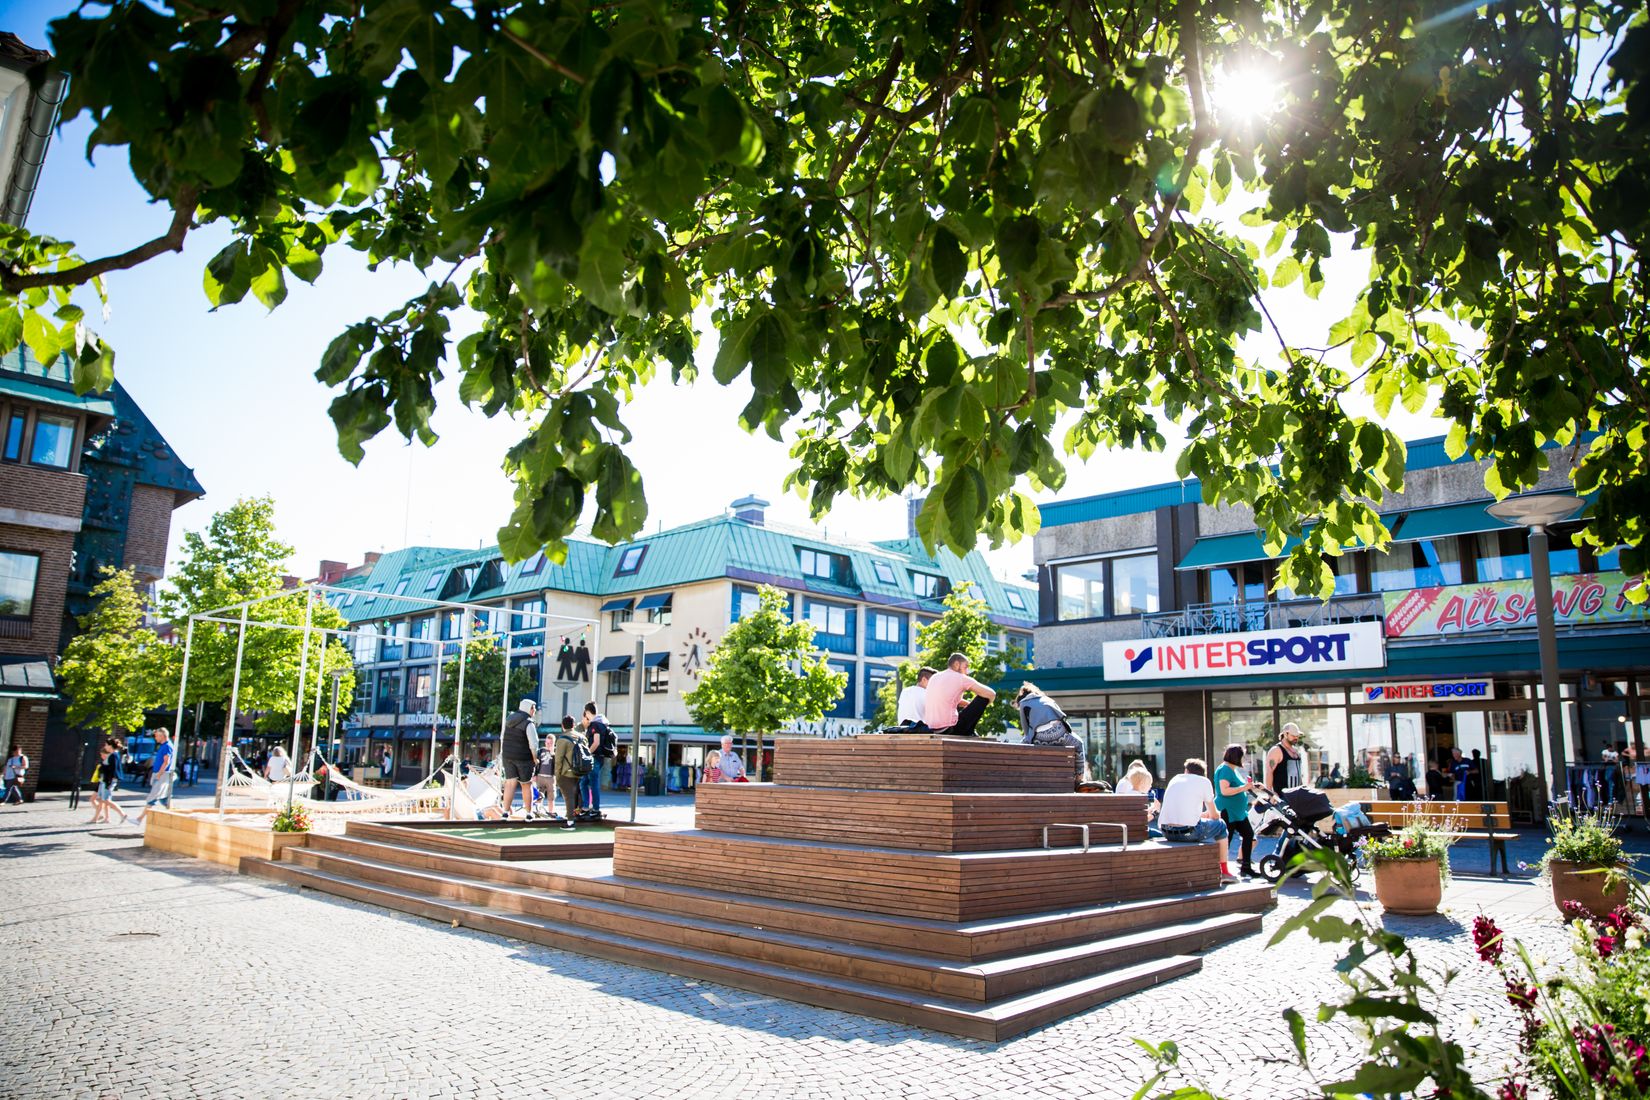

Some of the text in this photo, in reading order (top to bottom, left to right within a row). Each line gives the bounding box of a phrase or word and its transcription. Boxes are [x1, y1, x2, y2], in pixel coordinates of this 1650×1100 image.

[1158, 633, 1350, 671] INTERSPORT
[1384, 682, 1488, 699] INTERSPORT
[405, 711, 451, 725] BRÖDENA
